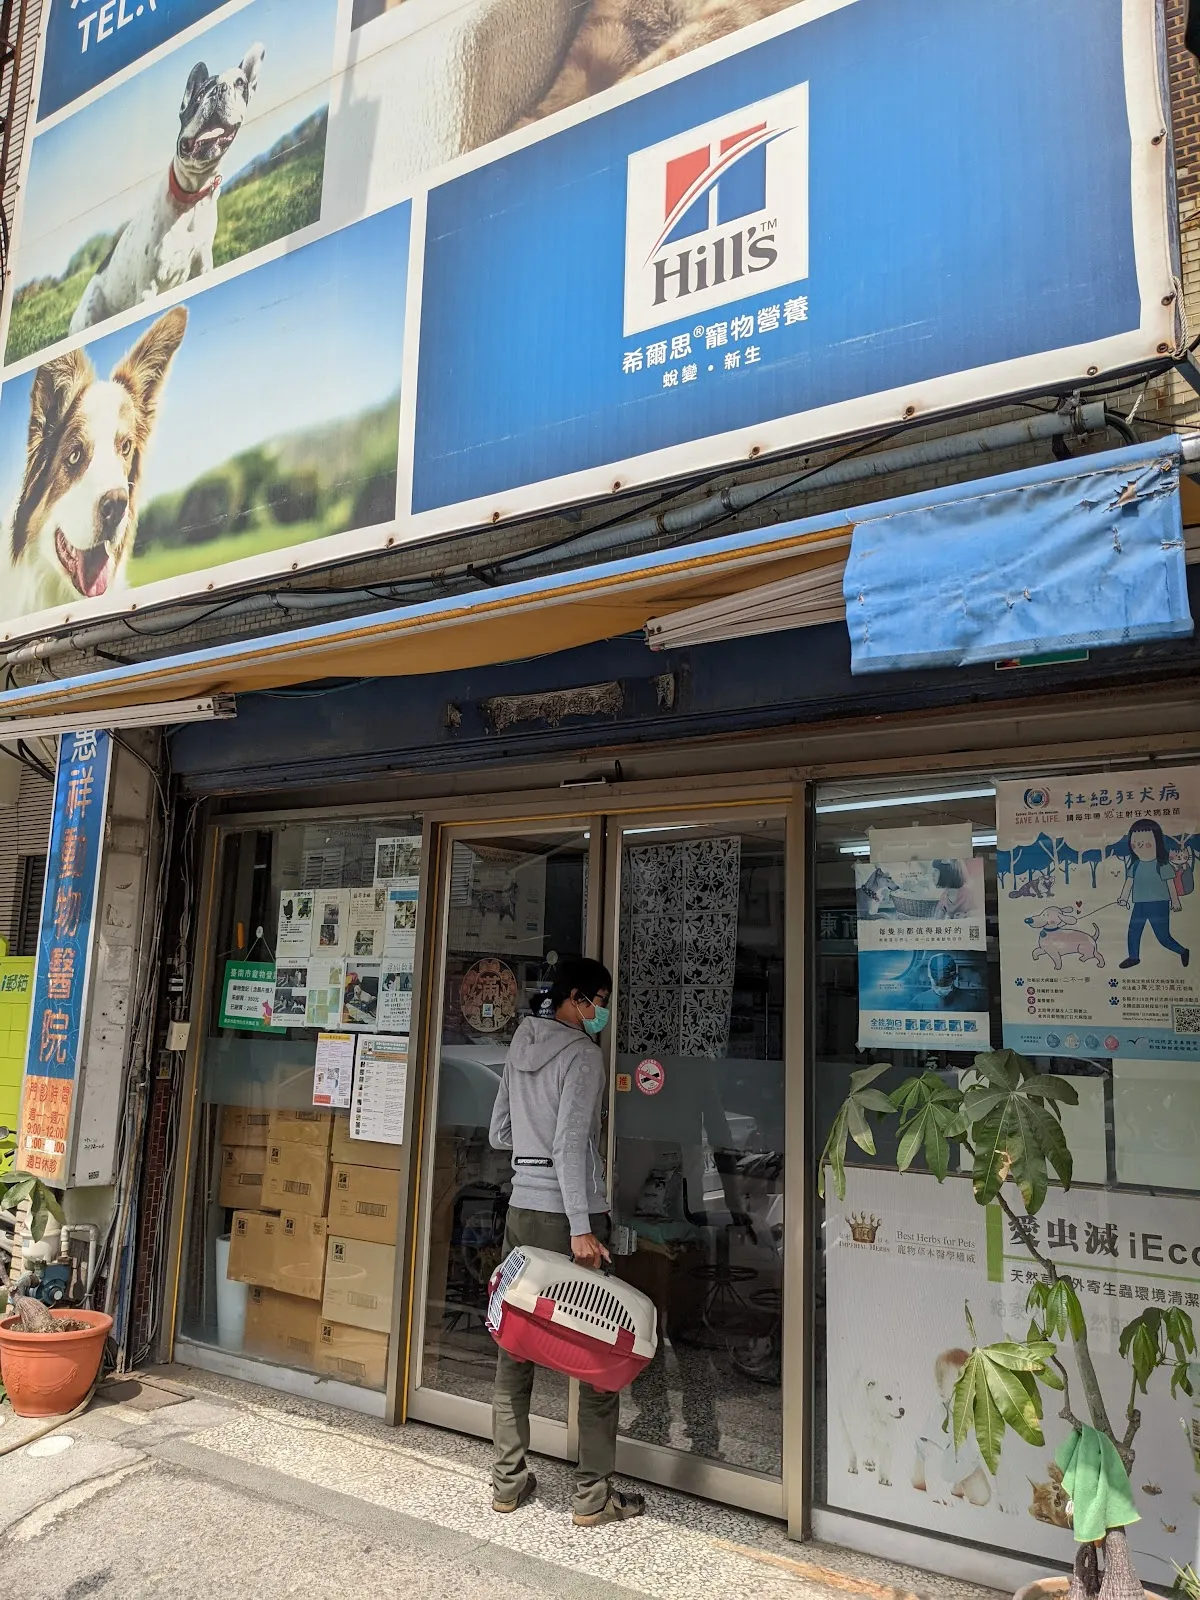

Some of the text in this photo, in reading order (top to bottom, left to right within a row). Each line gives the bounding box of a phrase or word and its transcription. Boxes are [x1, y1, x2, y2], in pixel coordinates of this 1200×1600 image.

[652, 227, 778, 307] Hill's
[1064, 782, 1180, 810] 杜絕狂犬病
[1015, 816, 1033, 825] SAVE
[230, 968, 276, 980] 臺南市寵物登
[896, 1231, 915, 1241] Best
[917, 1233, 940, 1246] Herbs
[943, 1236, 956, 1246] for
[958, 1238, 976, 1249] Pets
